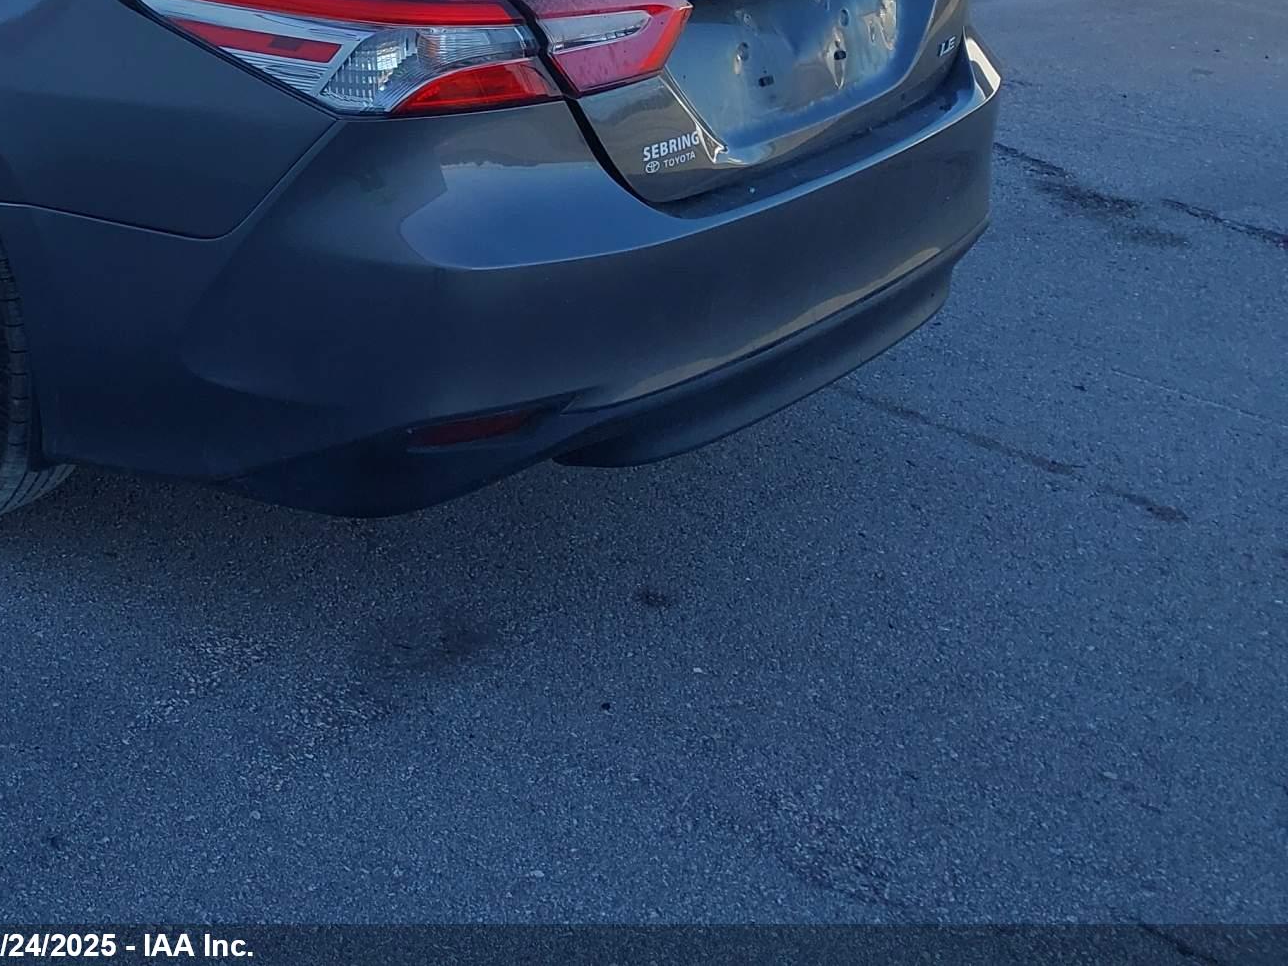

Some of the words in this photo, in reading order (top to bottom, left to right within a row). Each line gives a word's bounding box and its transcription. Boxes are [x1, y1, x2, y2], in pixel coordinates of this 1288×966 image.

[938, 35, 957, 57] LE
[642, 130, 700, 162] SEBRING
[663, 150, 696, 168] TOYOTA
